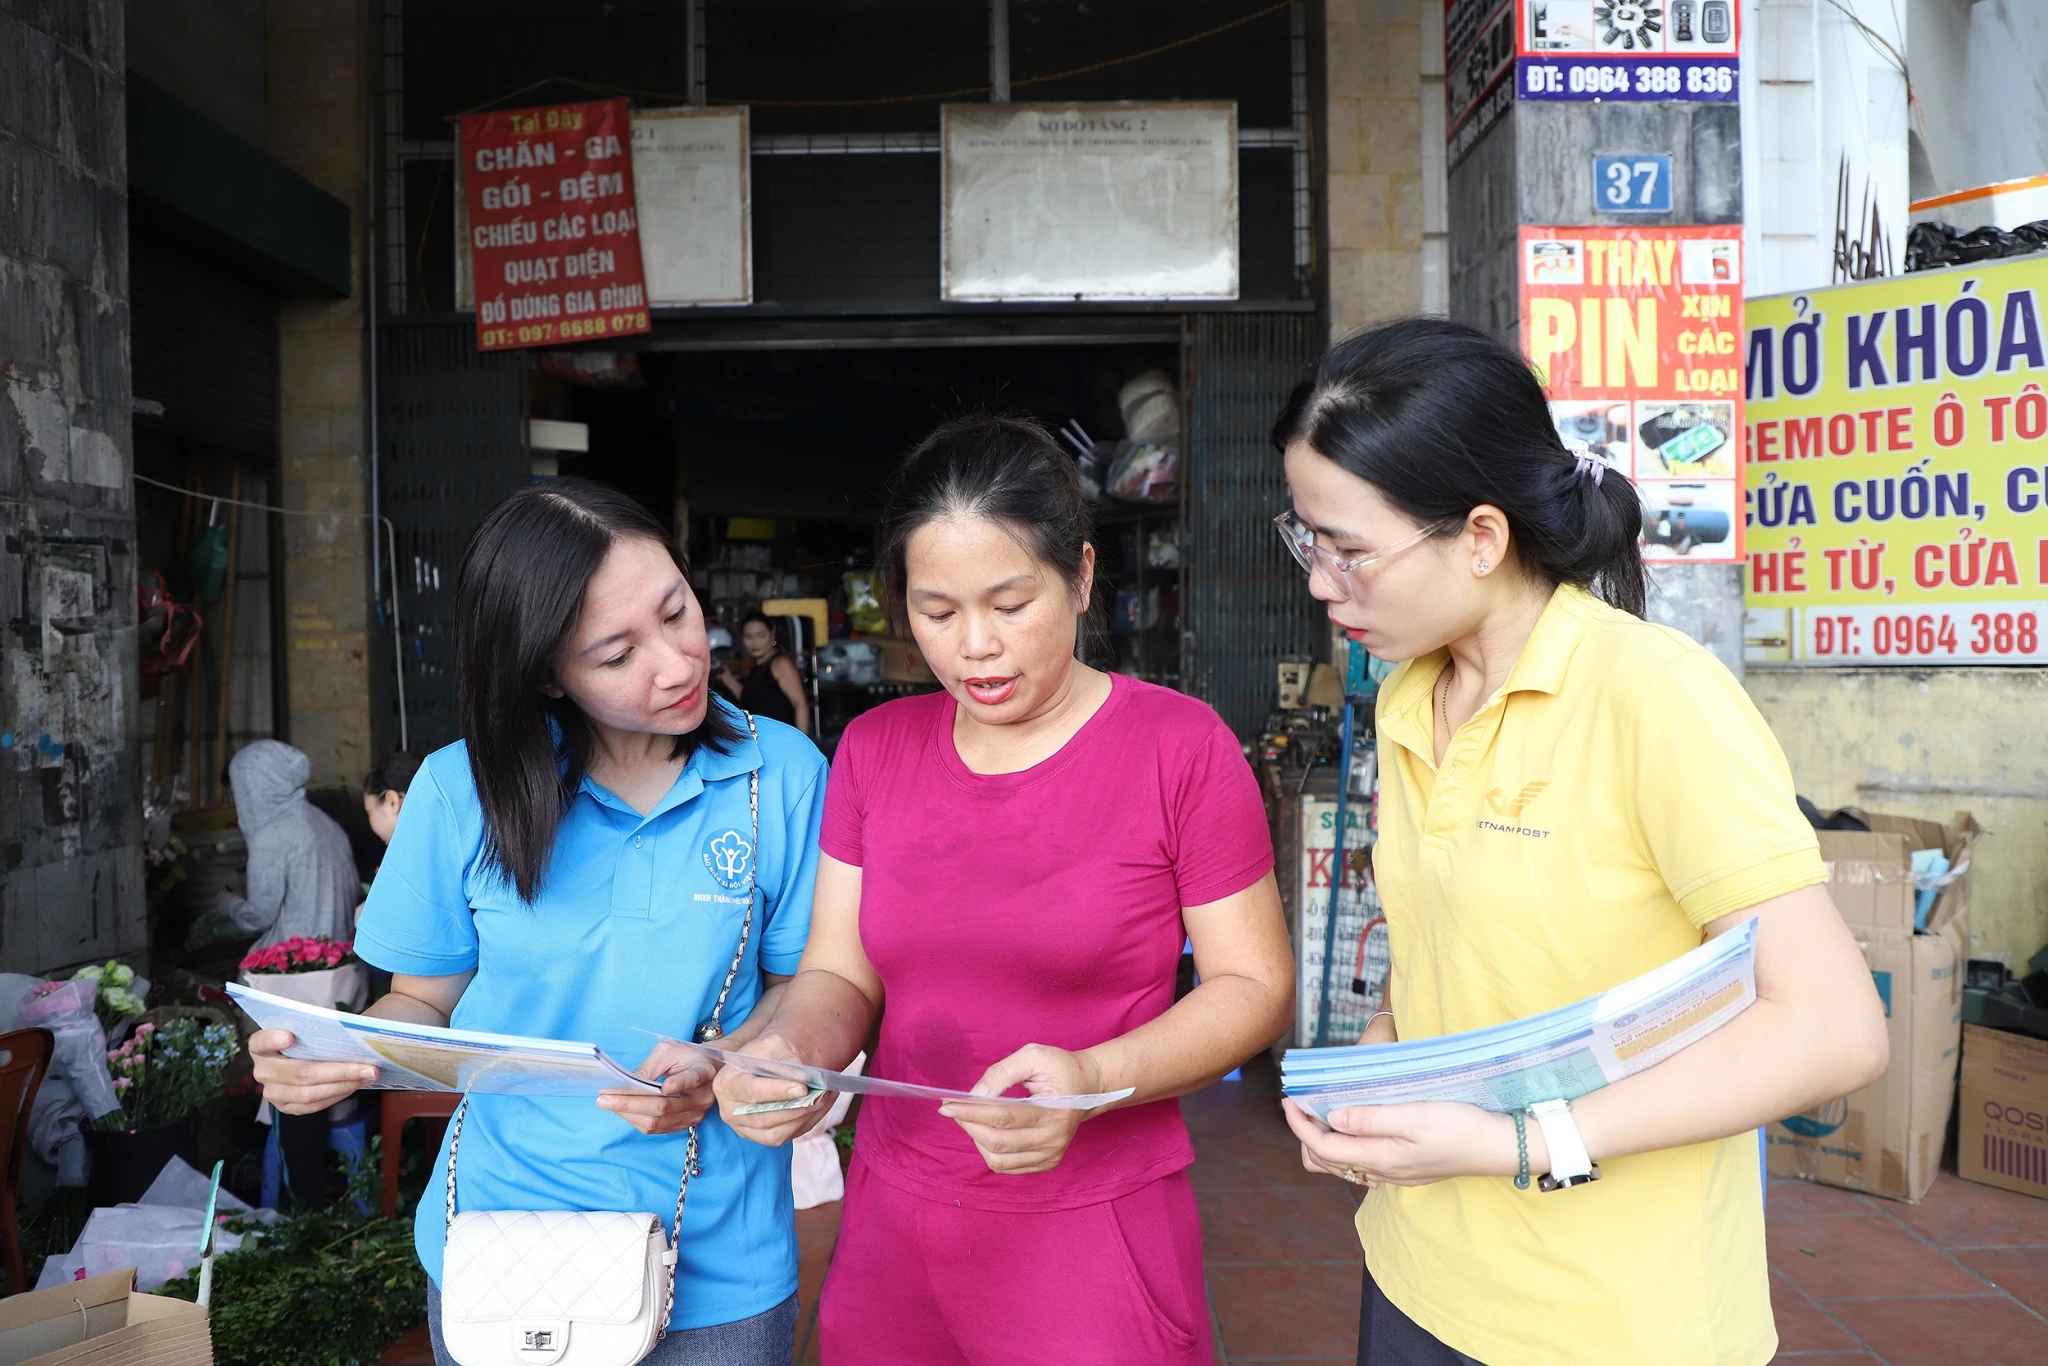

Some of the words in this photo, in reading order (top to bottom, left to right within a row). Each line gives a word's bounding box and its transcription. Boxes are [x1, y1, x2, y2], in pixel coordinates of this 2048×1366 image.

[1528, 66, 1563, 92] ĐT:
[1570, 66, 1630, 92] 0964
[1636, 67, 1681, 92] 388
[1687, 67, 1732, 92] 836
[510, 113, 540, 132] Tại
[546, 110, 583, 130] Đây
[475, 140, 556, 172] CHĂN
[584, 135, 622, 159] GA
[482, 175, 531, 210] GỐI
[559, 170, 624, 204] ĐỆM
[1606, 162, 1659, 204] 37
[474, 214, 537, 248] CHIẾU
[543, 212, 586, 241] CÁC
[504, 256, 558, 286] QUẠT
[565, 247, 615, 279] ĐIỆN
[1586, 240, 1677, 286] THAY
[565, 290, 596, 314] GIA
[600, 282, 644, 310] ĐÌNH
[1681, 295, 1731, 322] XỊN
[482, 328, 513, 347] ĐT:
[519, 323, 553, 343] 097
[559, 317, 605, 337] 6688
[612, 312, 647, 331] 078
[1530, 298, 1658, 387] PIN
[1677, 328, 1735, 355] CÁC
[1847, 280, 2045, 389] KHÓA
[1675, 369, 1738, 396] LOẠI
[1934, 392, 1964, 447] Ô
[1984, 383, 2048, 442] TÔ
[1834, 459, 1986, 523] CUỐN,
[2007, 466, 2048, 514] C
[1746, 537, 1807, 593] HẺ
[1824, 538, 1895, 596] TỪ,
[1915, 527, 2019, 589] CỬA
[1815, 616, 1861, 655] ĐT:
[1874, 615, 1957, 655] 0964
[1970, 612, 2038, 655] 388
[1516, 827, 1550, 838] POST
[1984, 1101, 2048, 1134] QOS
